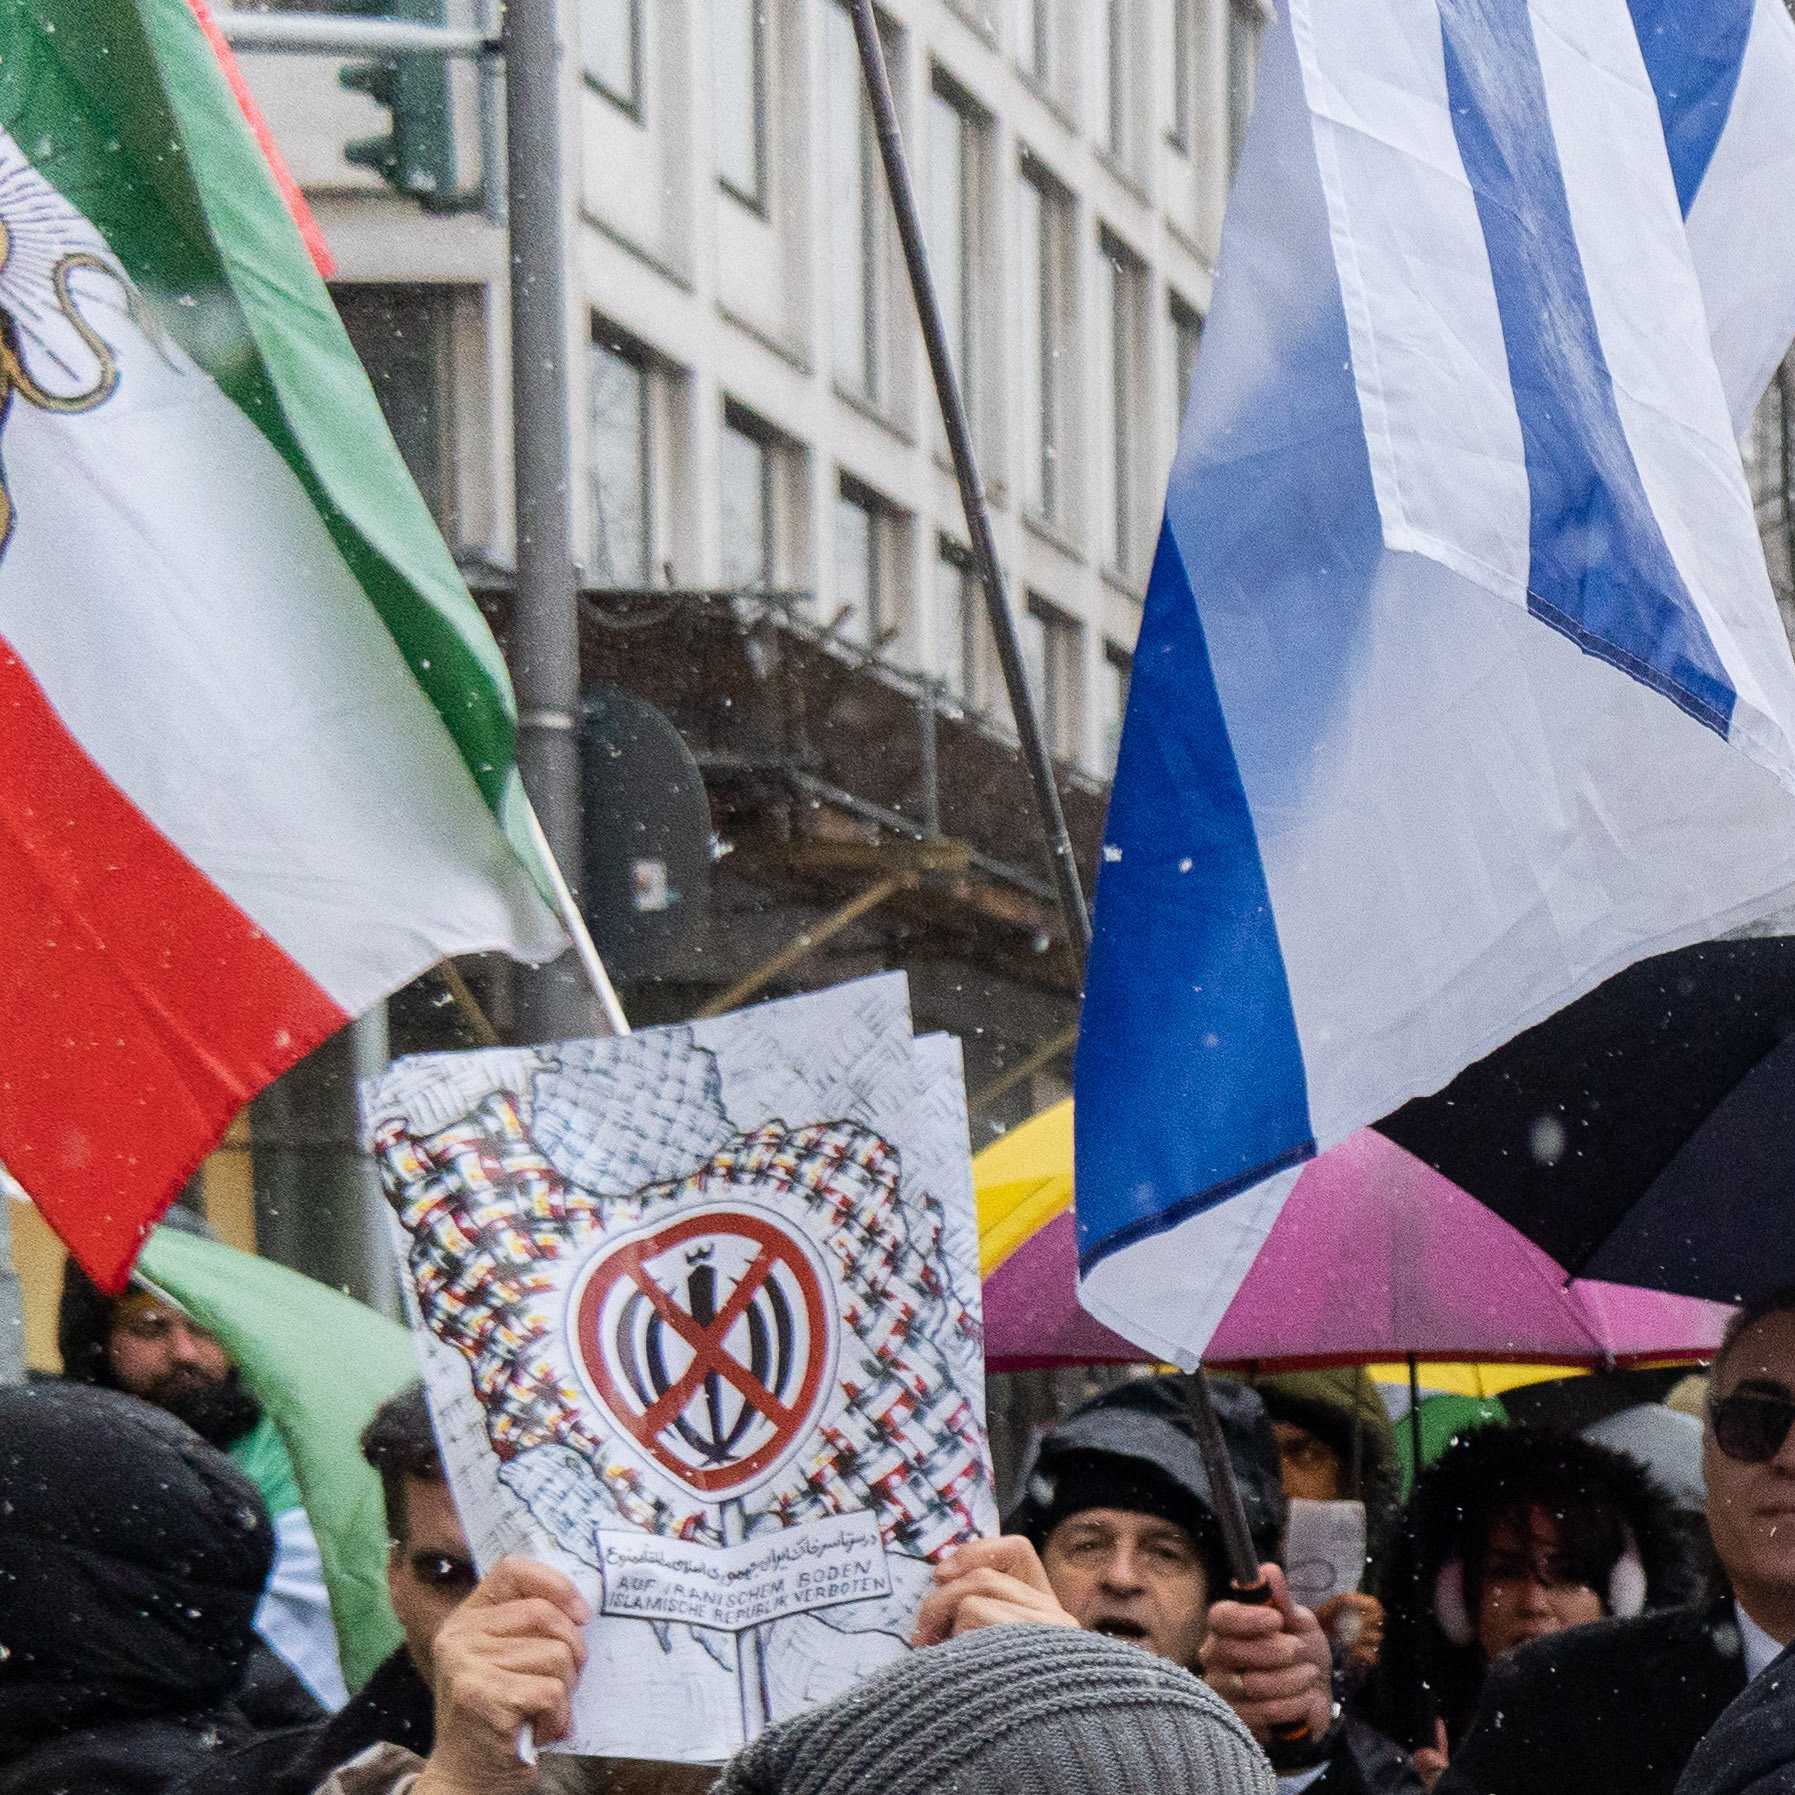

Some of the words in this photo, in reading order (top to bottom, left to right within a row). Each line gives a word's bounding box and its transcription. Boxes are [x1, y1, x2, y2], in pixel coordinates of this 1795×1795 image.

[608, 1591, 706, 1619] ISLAMISCHE
[713, 1595, 789, 1624] REPUBLIK
[794, 1577, 886, 1602] VERBOTEN
[618, 1576, 657, 1592] AUF
[663, 1578, 786, 1607] IRANISCHEM
[799, 1559, 872, 1588] BODEN
